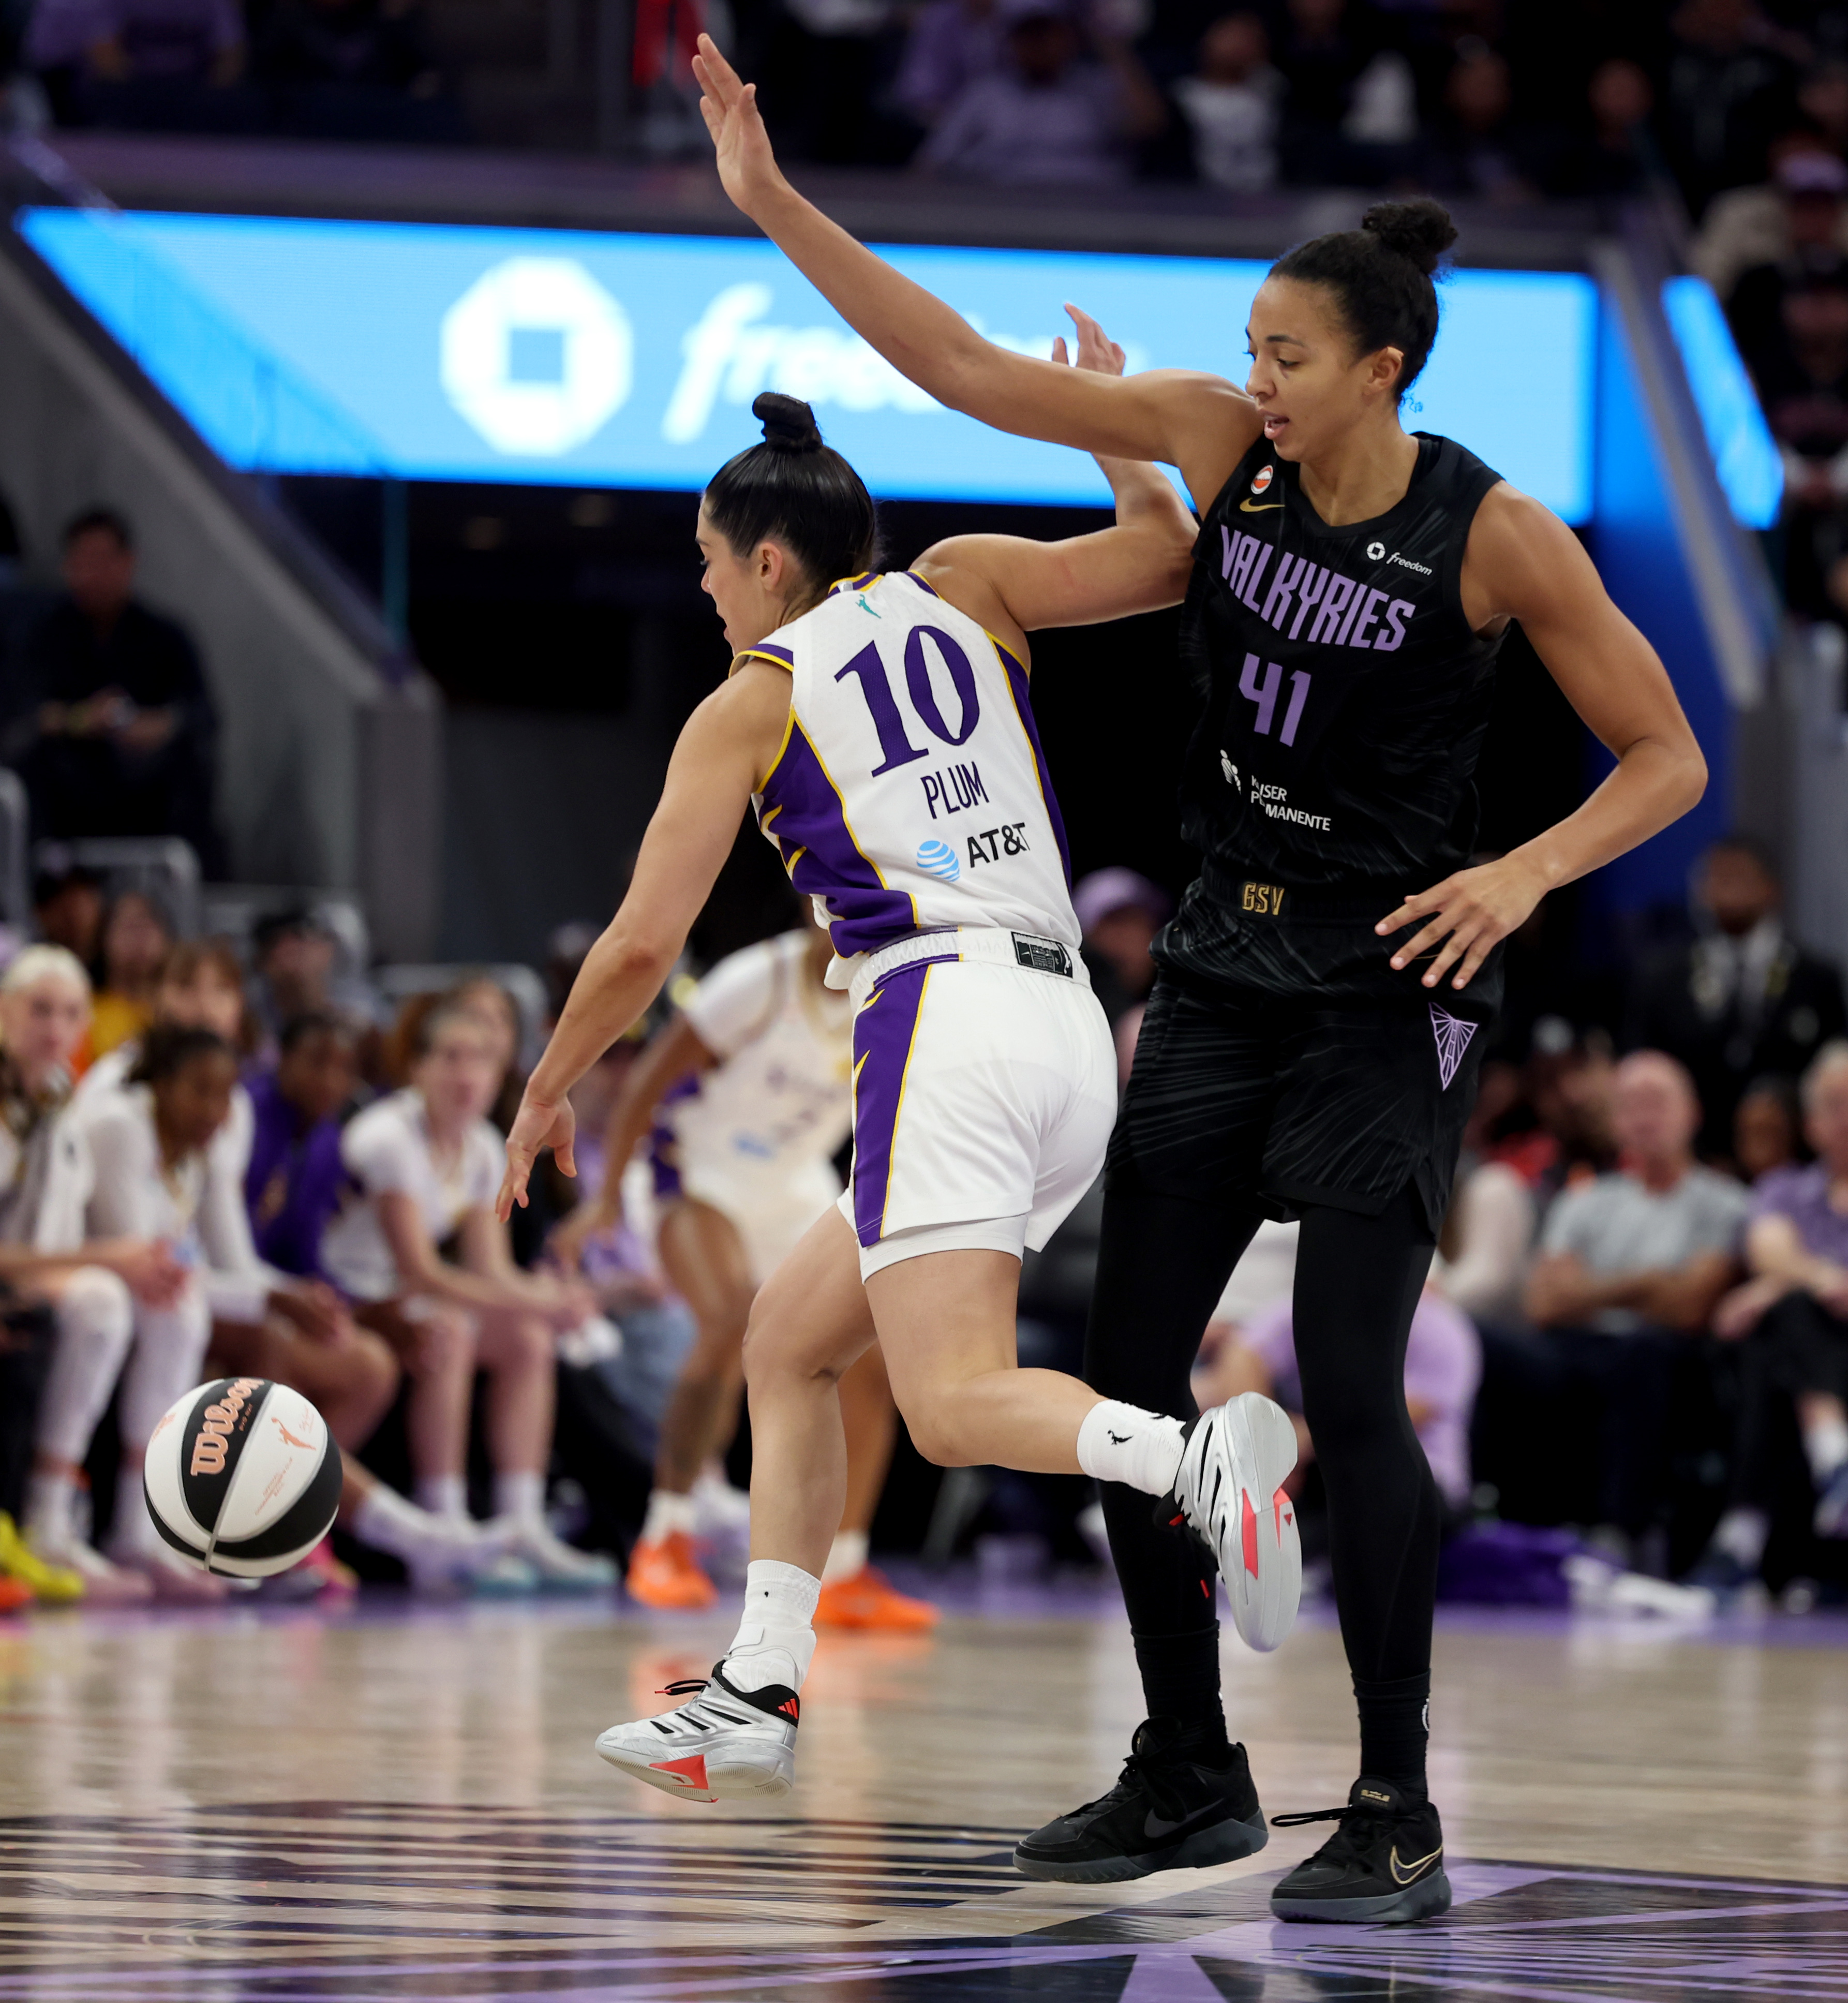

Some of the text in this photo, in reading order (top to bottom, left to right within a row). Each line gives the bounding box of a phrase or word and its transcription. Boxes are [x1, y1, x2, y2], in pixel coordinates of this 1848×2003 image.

[1220, 524, 1416, 651] VALKYRIES
[1386, 552, 1433, 576] freedom
[834, 625, 979, 777] 10
[1239, 652, 1312, 747] 41
[920, 761, 990, 820] PLUM
[1251, 775, 1287, 802] KISER
[967, 822, 1031, 868] AT&T
[1242, 882, 1285, 916] GSV
[190, 1377, 265, 1476] Wilson
